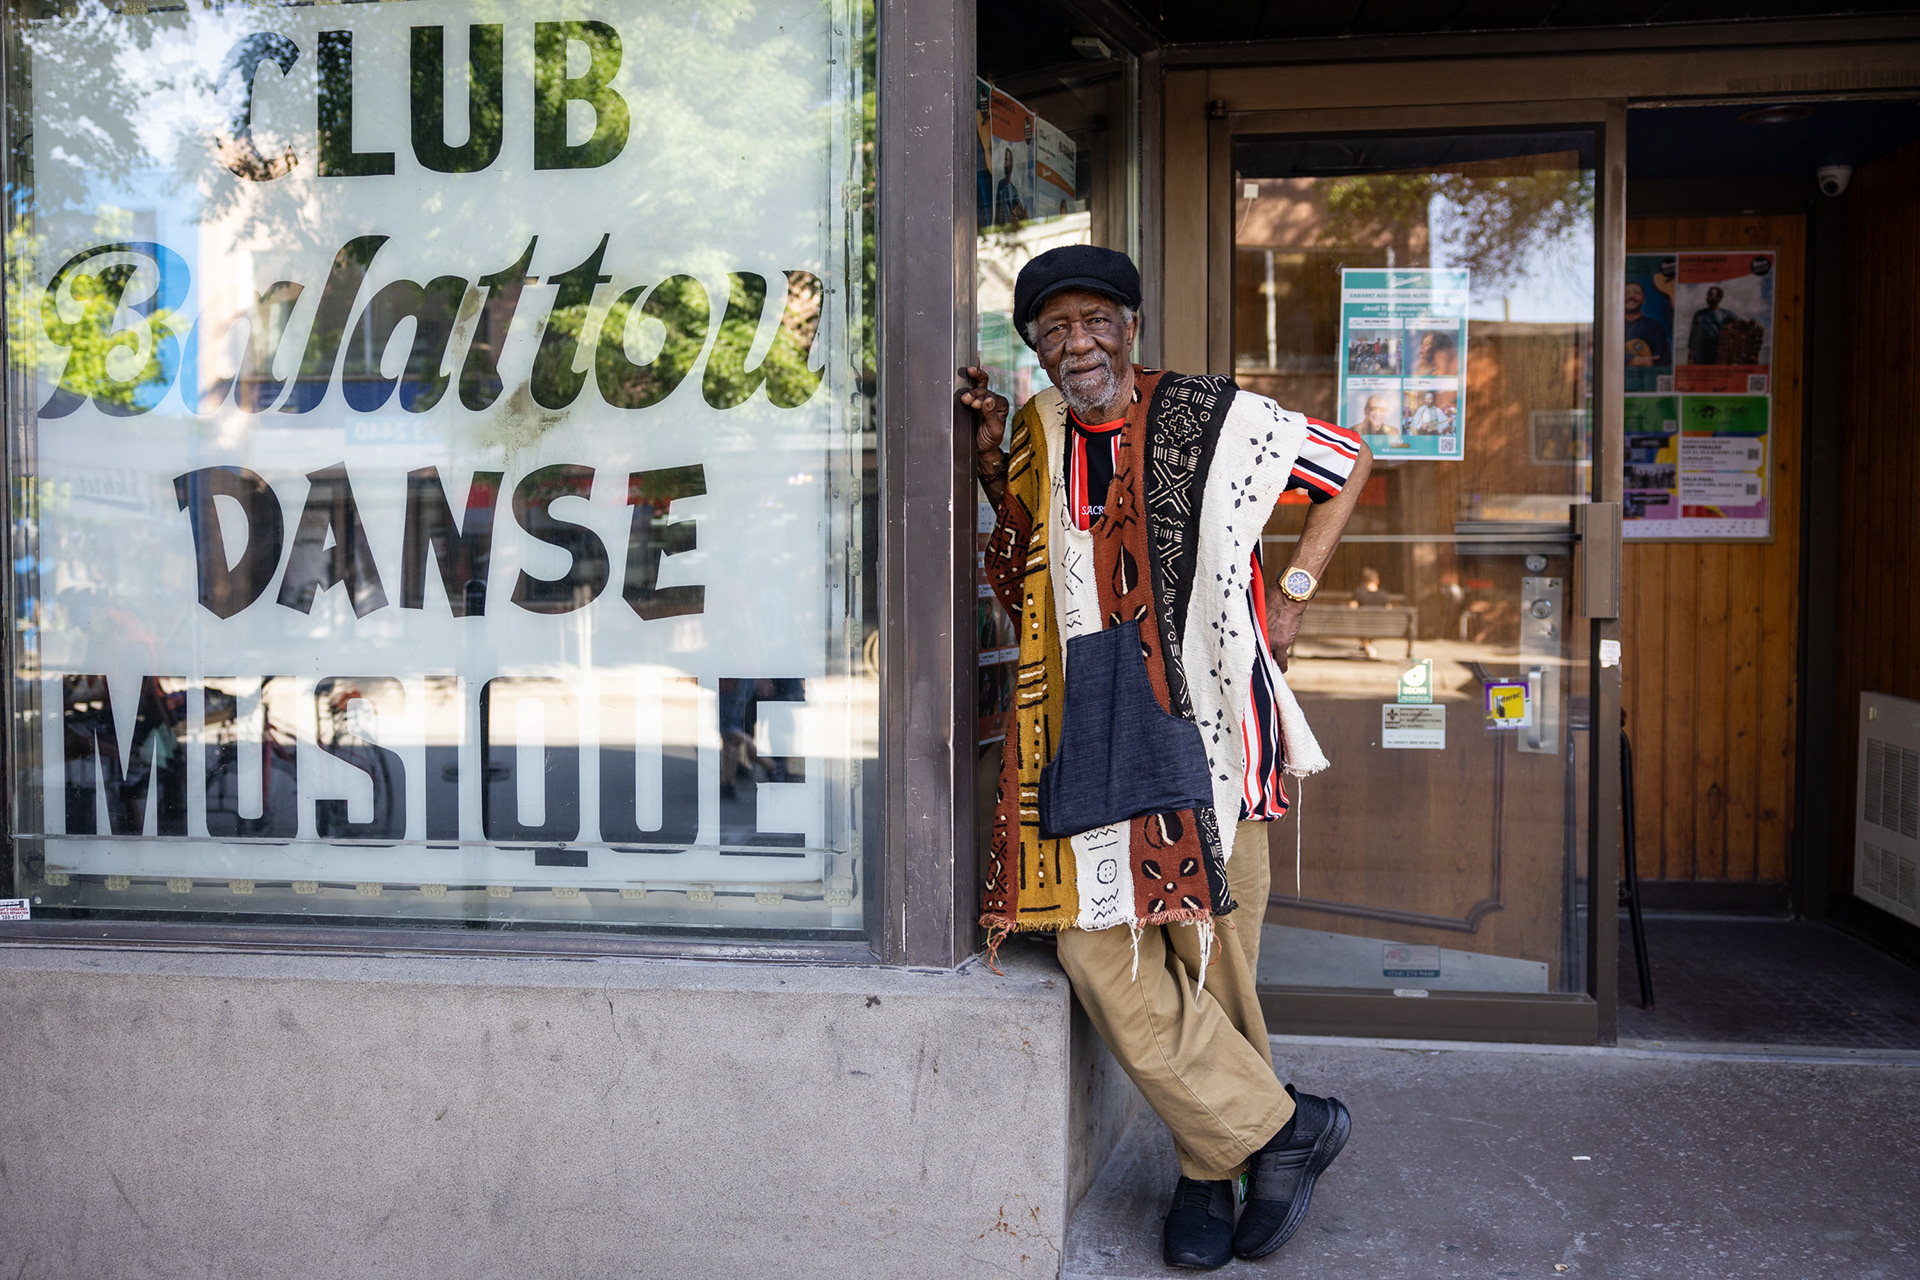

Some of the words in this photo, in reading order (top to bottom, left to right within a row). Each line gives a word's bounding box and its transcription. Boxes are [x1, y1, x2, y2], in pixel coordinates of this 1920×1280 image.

[215, 19, 632, 182] CLUB
[37, 232, 829, 420] Balattou
[172, 461, 707, 622] DANSE
[1081, 505, 1105, 515] SACR
[62, 674, 806, 868] MUSIQUE
